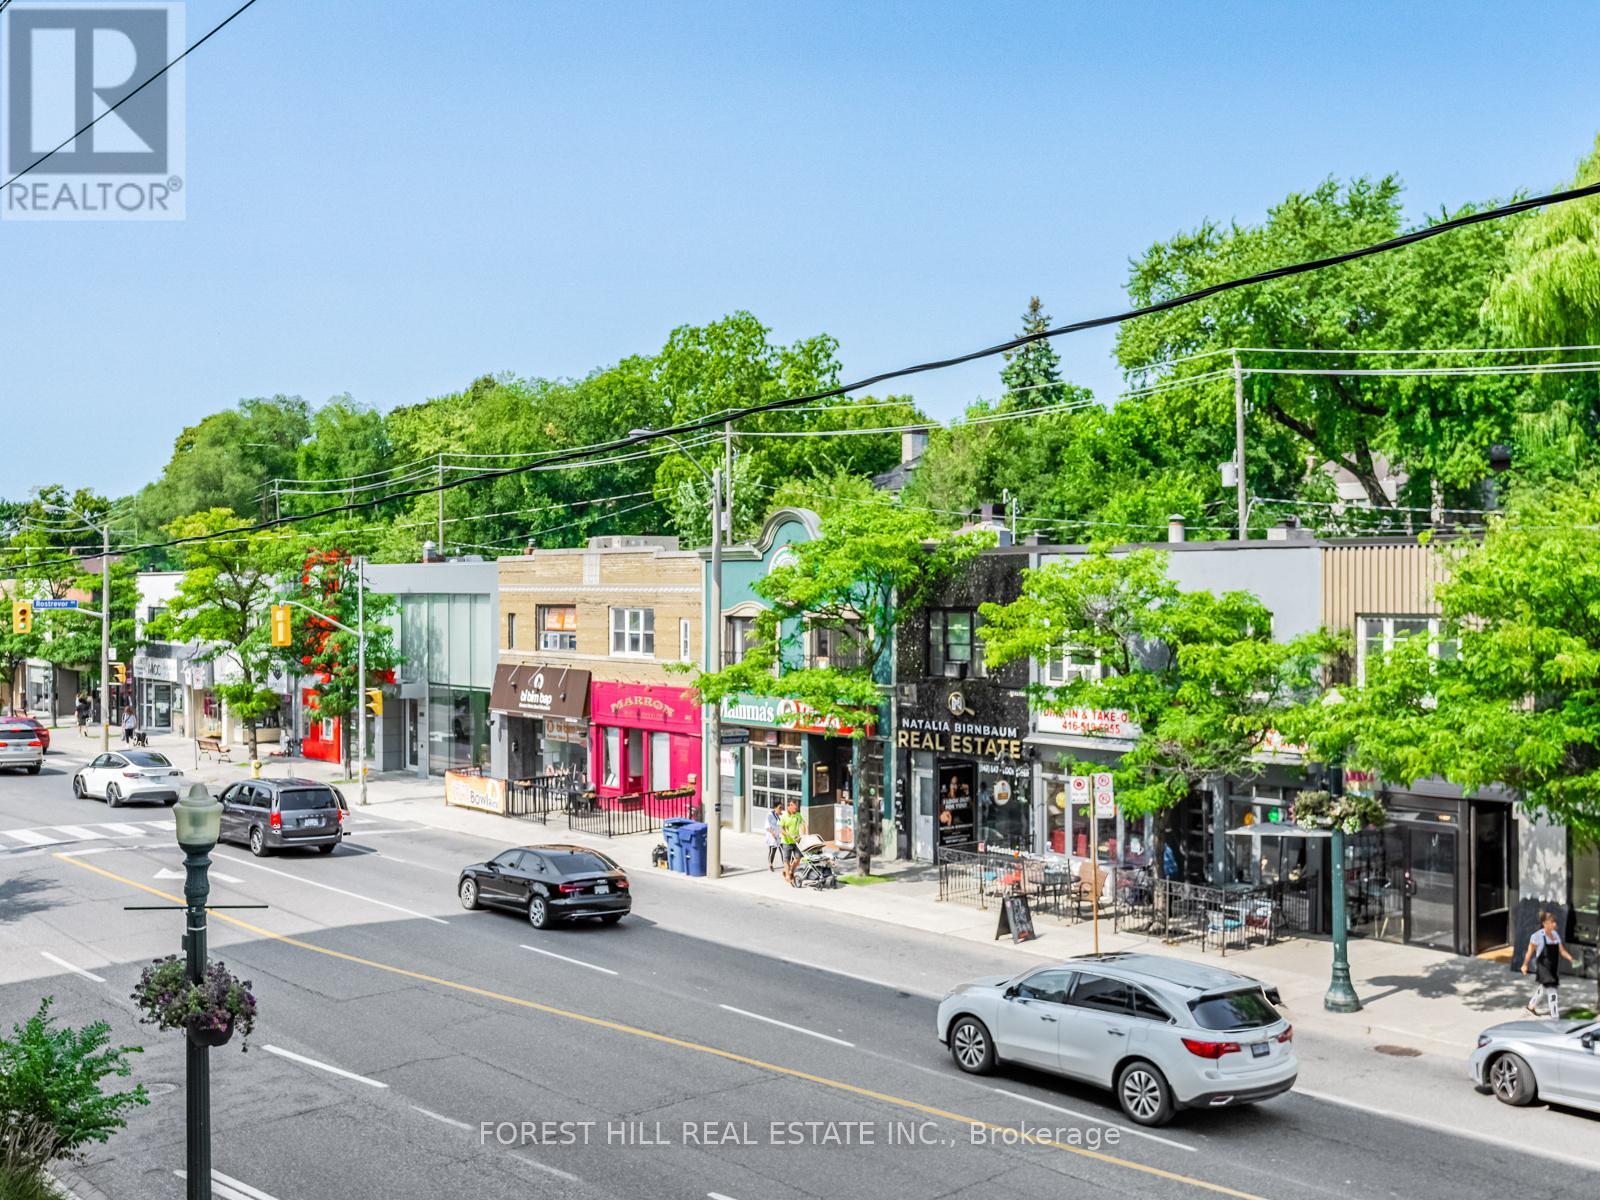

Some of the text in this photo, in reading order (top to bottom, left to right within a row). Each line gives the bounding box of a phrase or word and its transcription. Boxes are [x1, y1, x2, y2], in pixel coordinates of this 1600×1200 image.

[35, 600, 69, 608] Rostrevor
[610, 695, 675, 718] MARRON
[720, 697, 775, 723] Mamma's
[1081, 710, 1088, 720] &
[902, 718, 1018, 738] NATALIA BIRNBAUM
[897, 730, 1021, 760] REAL ESTATE
